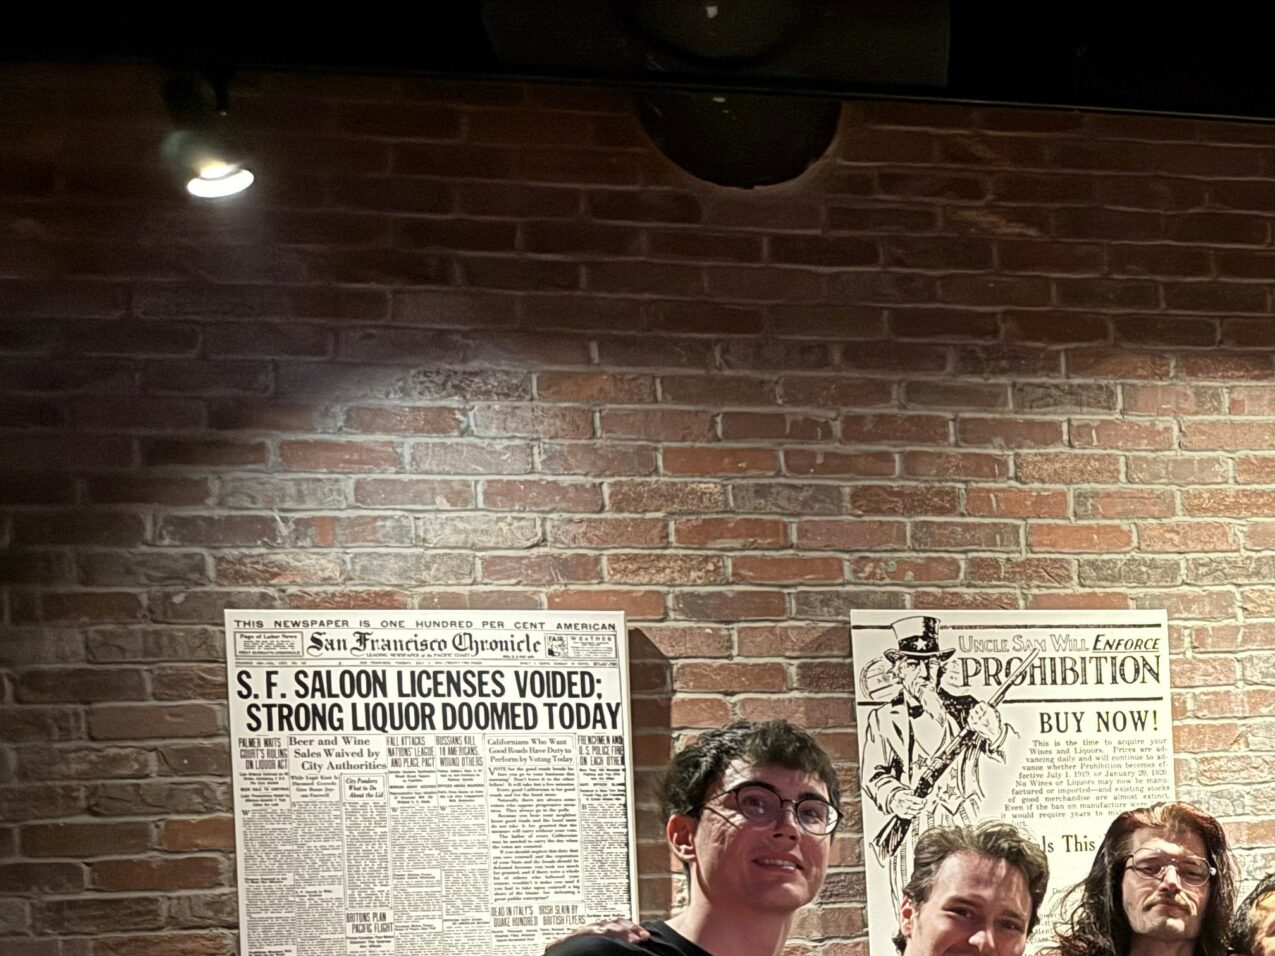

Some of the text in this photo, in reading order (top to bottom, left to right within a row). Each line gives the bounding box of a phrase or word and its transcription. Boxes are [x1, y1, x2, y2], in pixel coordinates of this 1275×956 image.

[307, 631, 348, 657] San
[350, 631, 447, 657] Francisco
[452, 632, 541, 657] Chronicle
[958, 655, 1161, 687] PROHIBITION
[236, 670, 258, 699] S.
[266, 670, 286, 698] F.
[294, 670, 387, 698] SALOON
[396, 670, 506, 698] LICENSES
[246, 702, 621, 733] STRONG LIQUOR DOOMED TODAY
[1040, 710, 1159, 733] BUY NOW!
[289, 736, 370, 746] Beer and Wine
[294, 749, 380, 760] Sales Waived by
[302, 761, 387, 772] City Authorities
[1062, 834, 1095, 853] This
